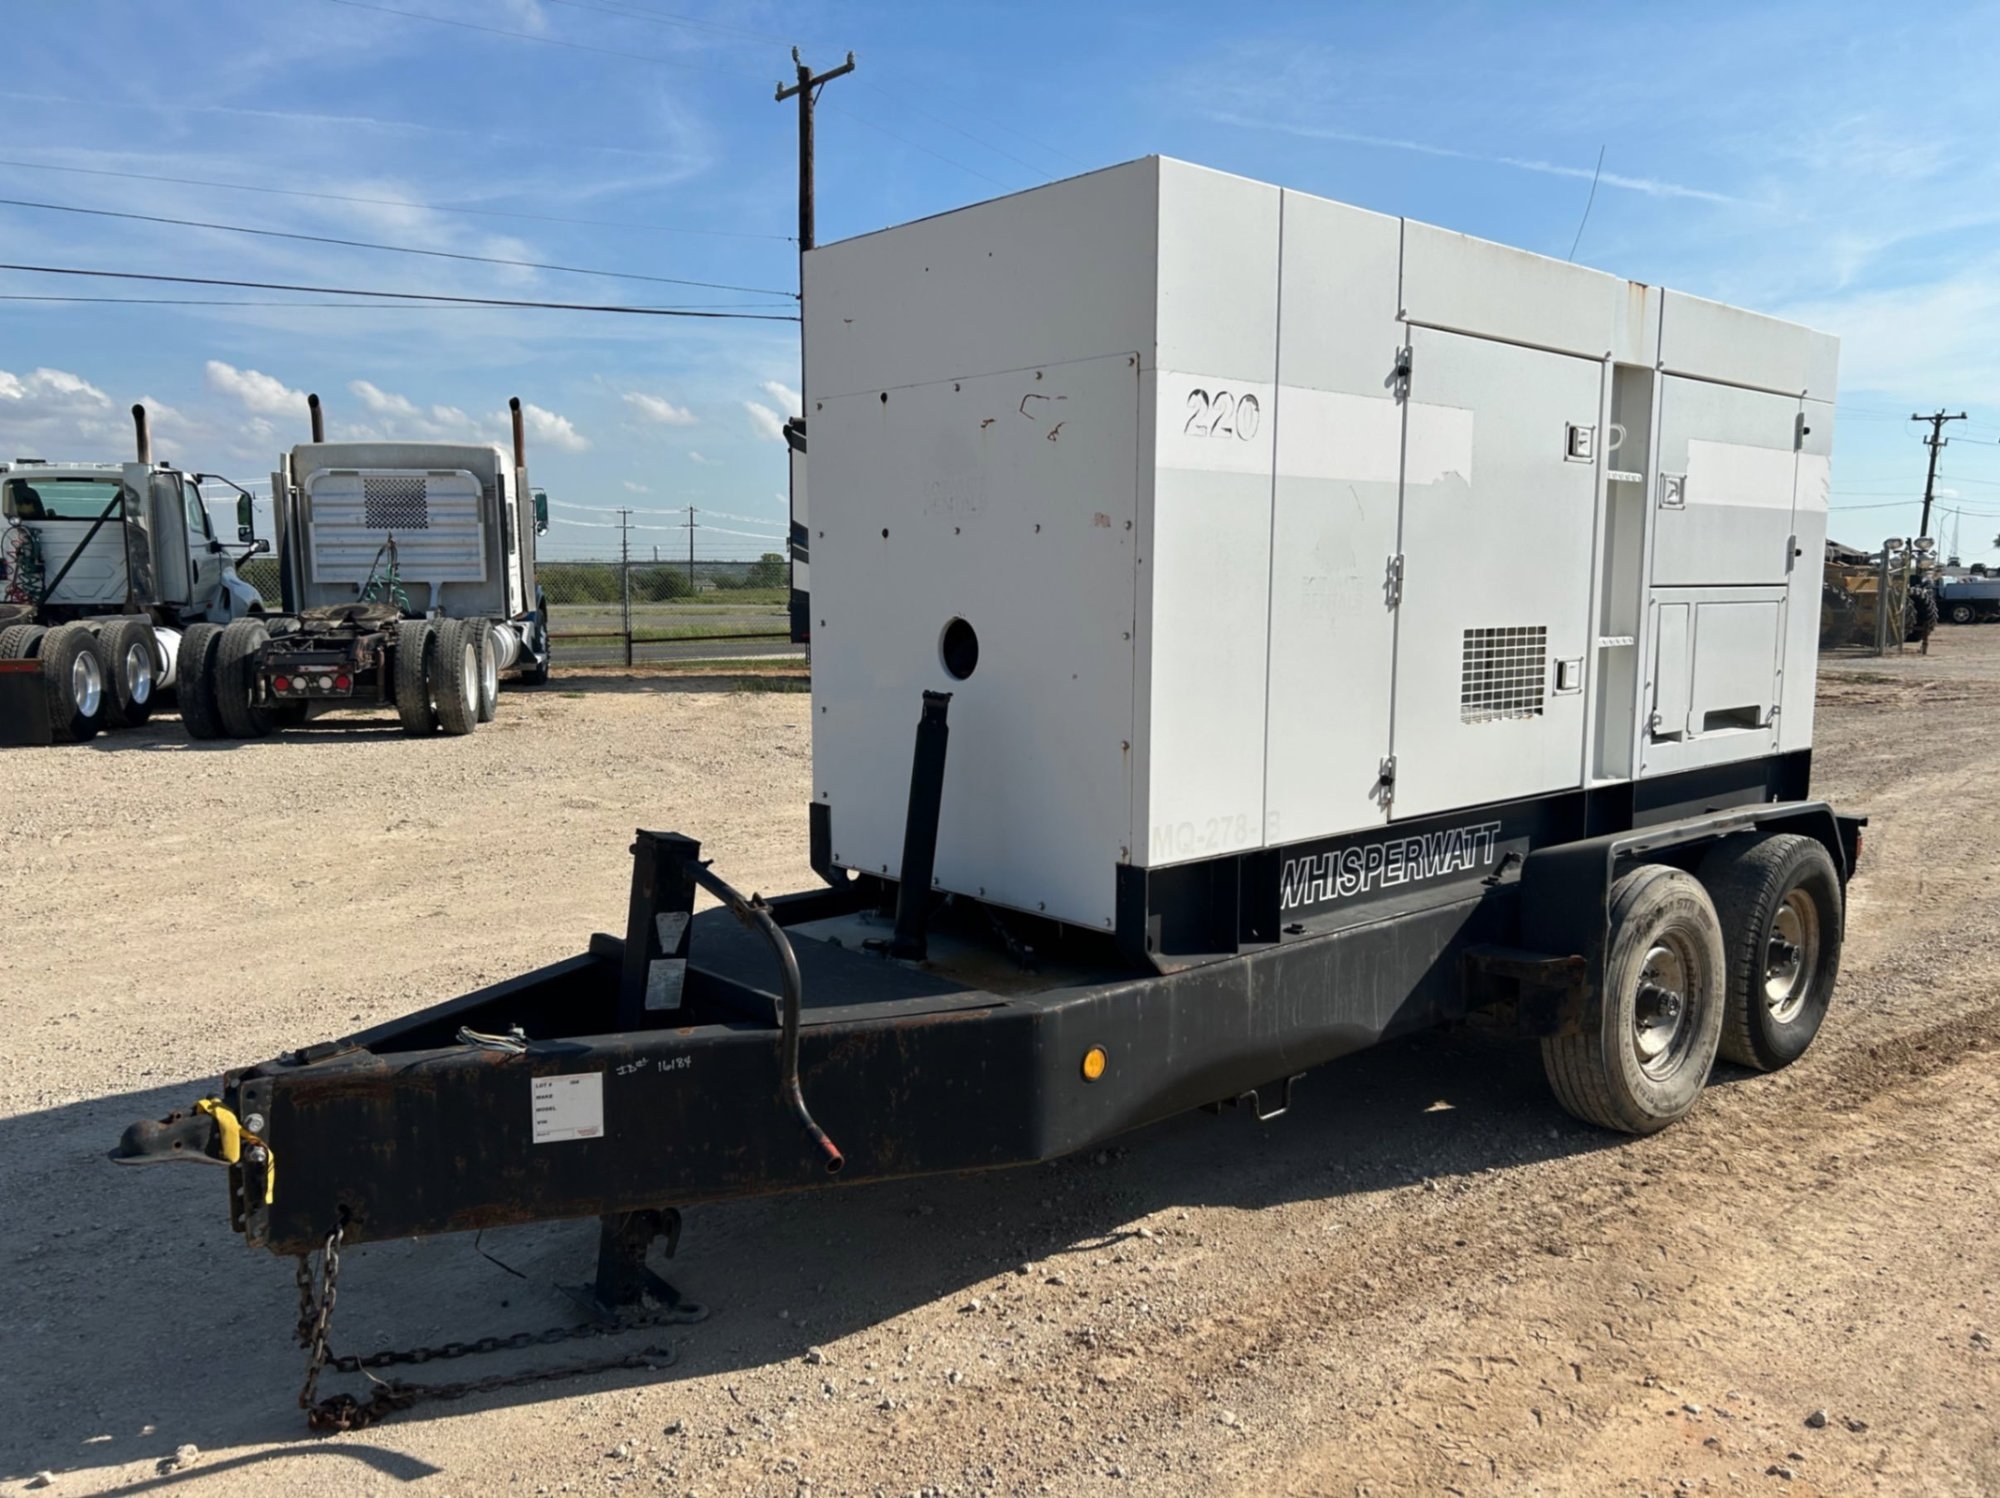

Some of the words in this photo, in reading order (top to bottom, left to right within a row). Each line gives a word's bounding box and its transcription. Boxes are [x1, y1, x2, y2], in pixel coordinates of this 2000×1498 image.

[1184, 388, 1260, 442] 220
[1280, 820, 1502, 910] WHISPERWATT
[657, 1055, 692, 1073] 16184
